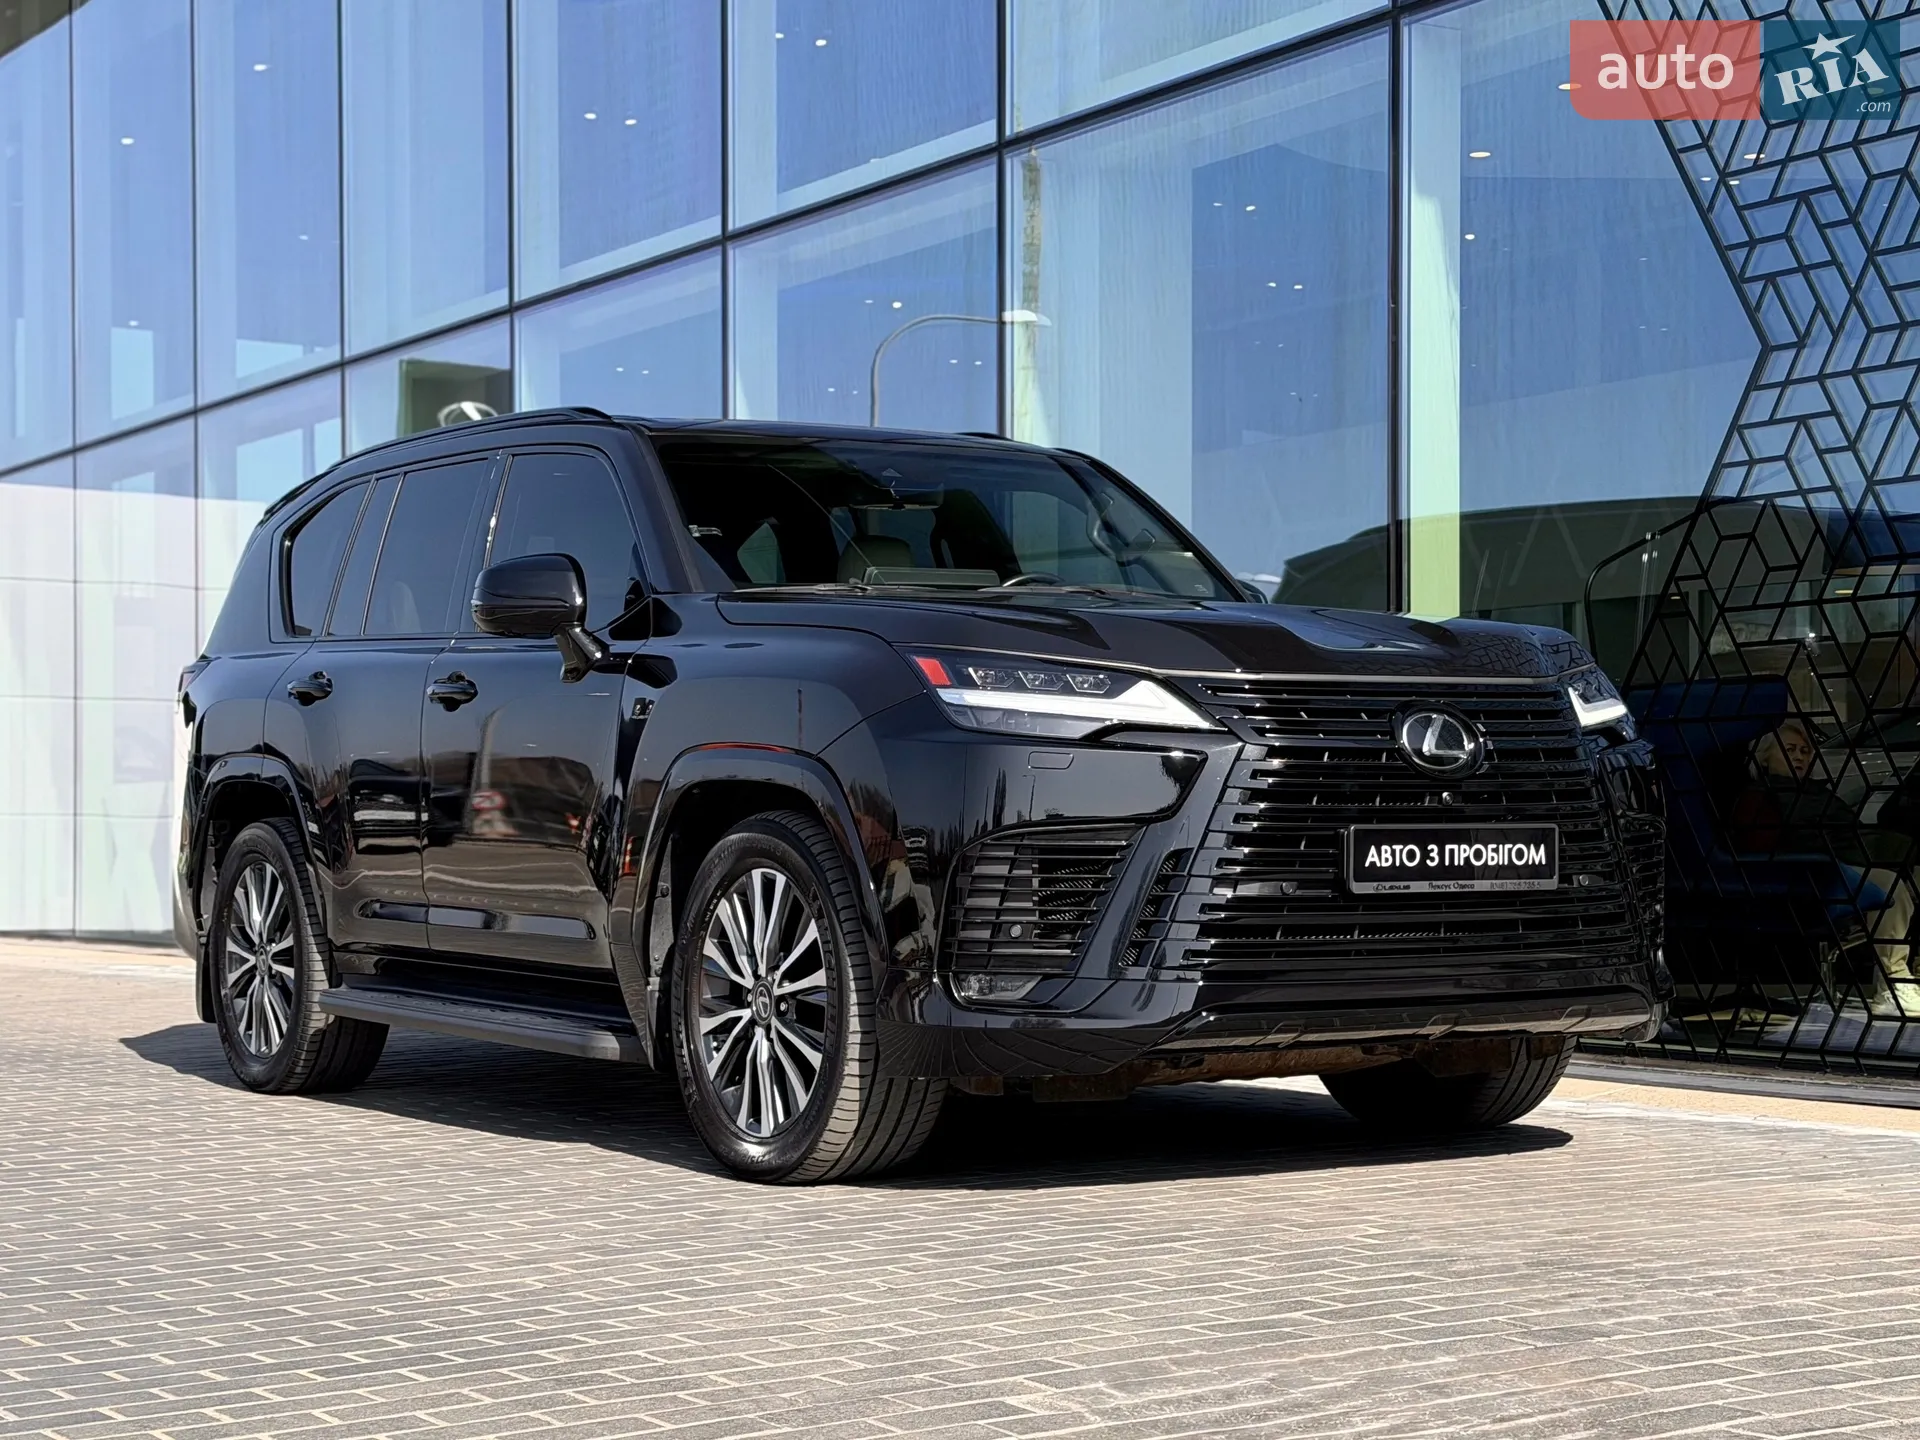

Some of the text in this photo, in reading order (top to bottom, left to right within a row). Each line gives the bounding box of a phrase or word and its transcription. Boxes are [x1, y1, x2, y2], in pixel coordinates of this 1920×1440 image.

[1365, 843, 1546, 868] АВТО З ПРОБІГОМ
